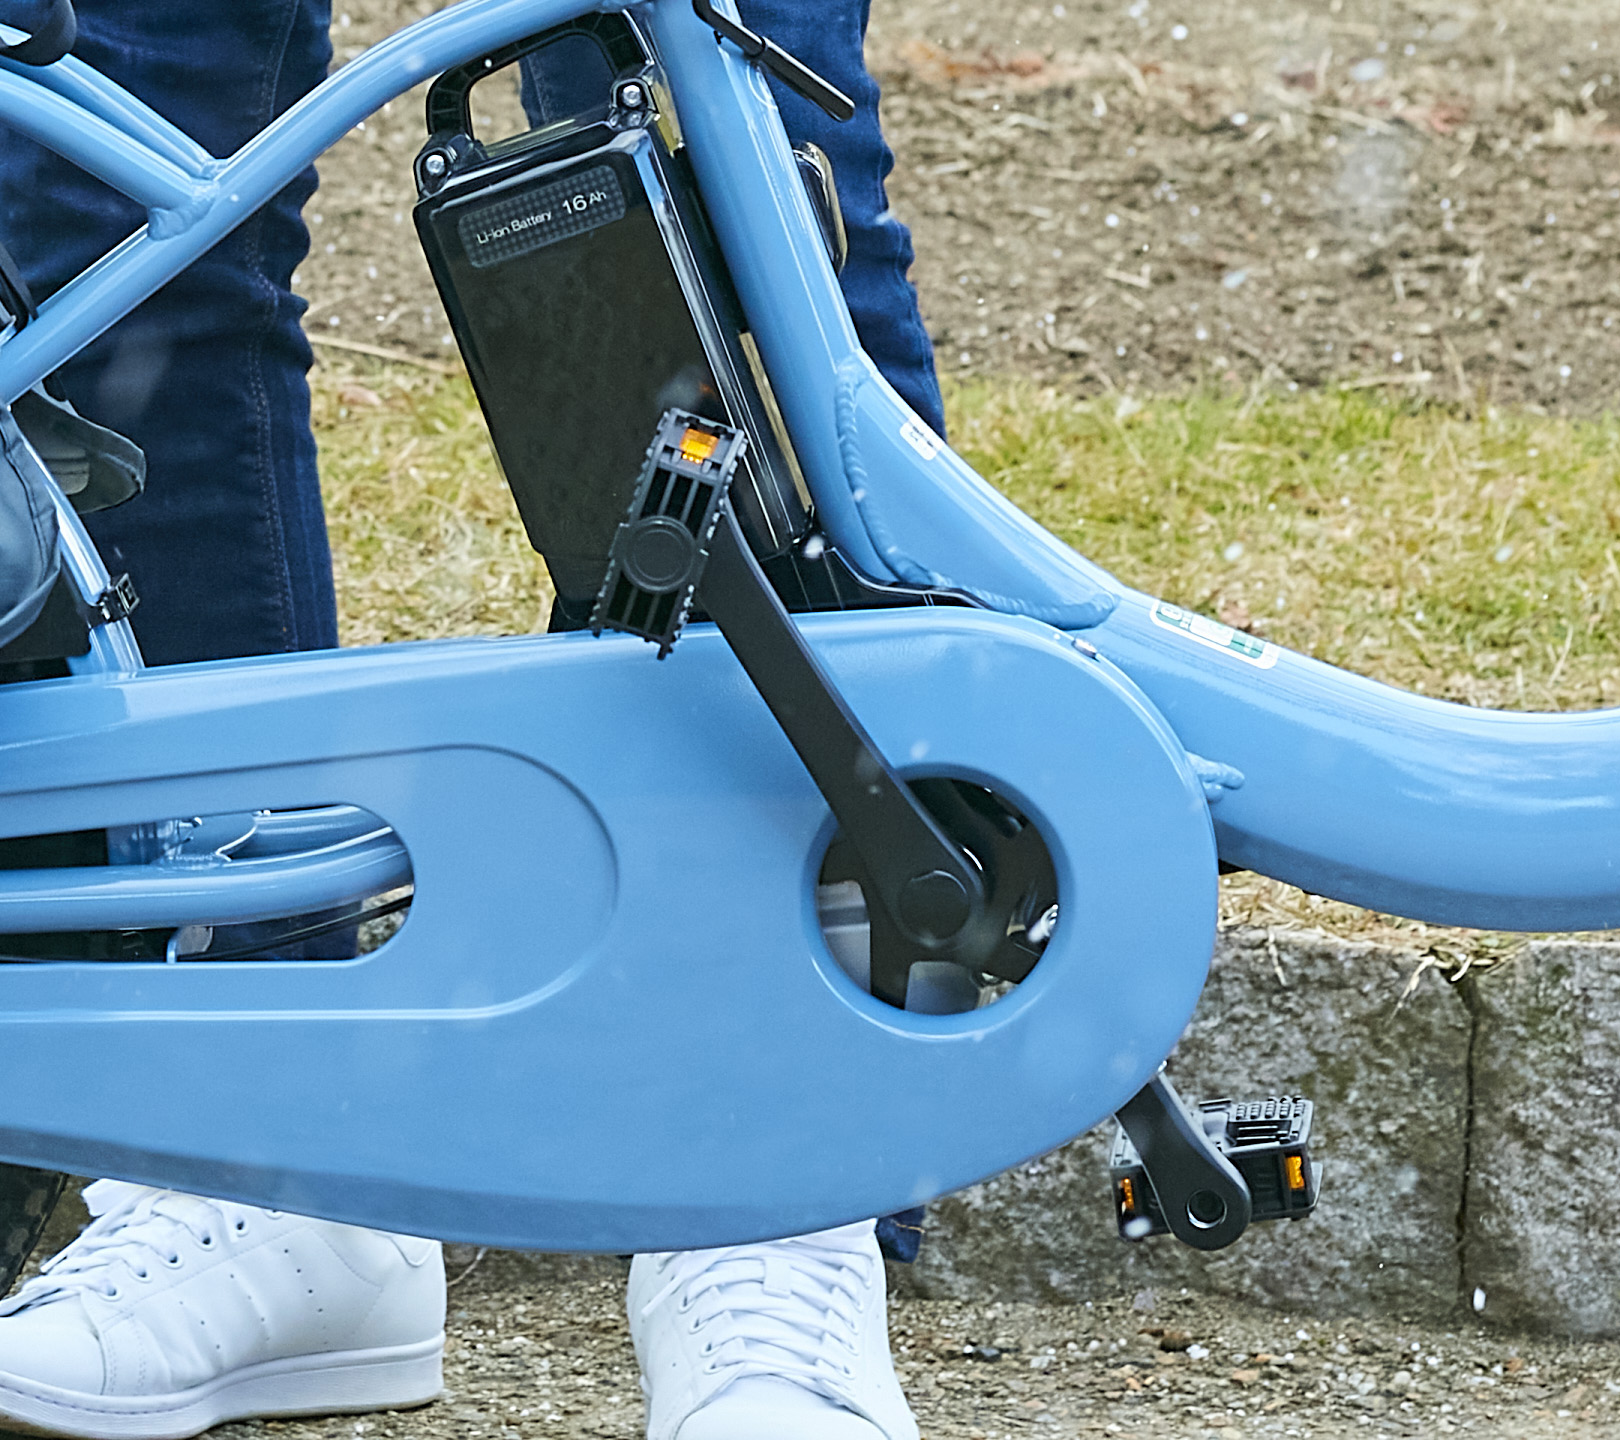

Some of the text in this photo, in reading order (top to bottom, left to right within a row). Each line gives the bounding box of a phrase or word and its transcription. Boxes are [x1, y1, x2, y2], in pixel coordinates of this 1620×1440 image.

[476, 189, 607, 245] Li-ion Battery 16 Ah
